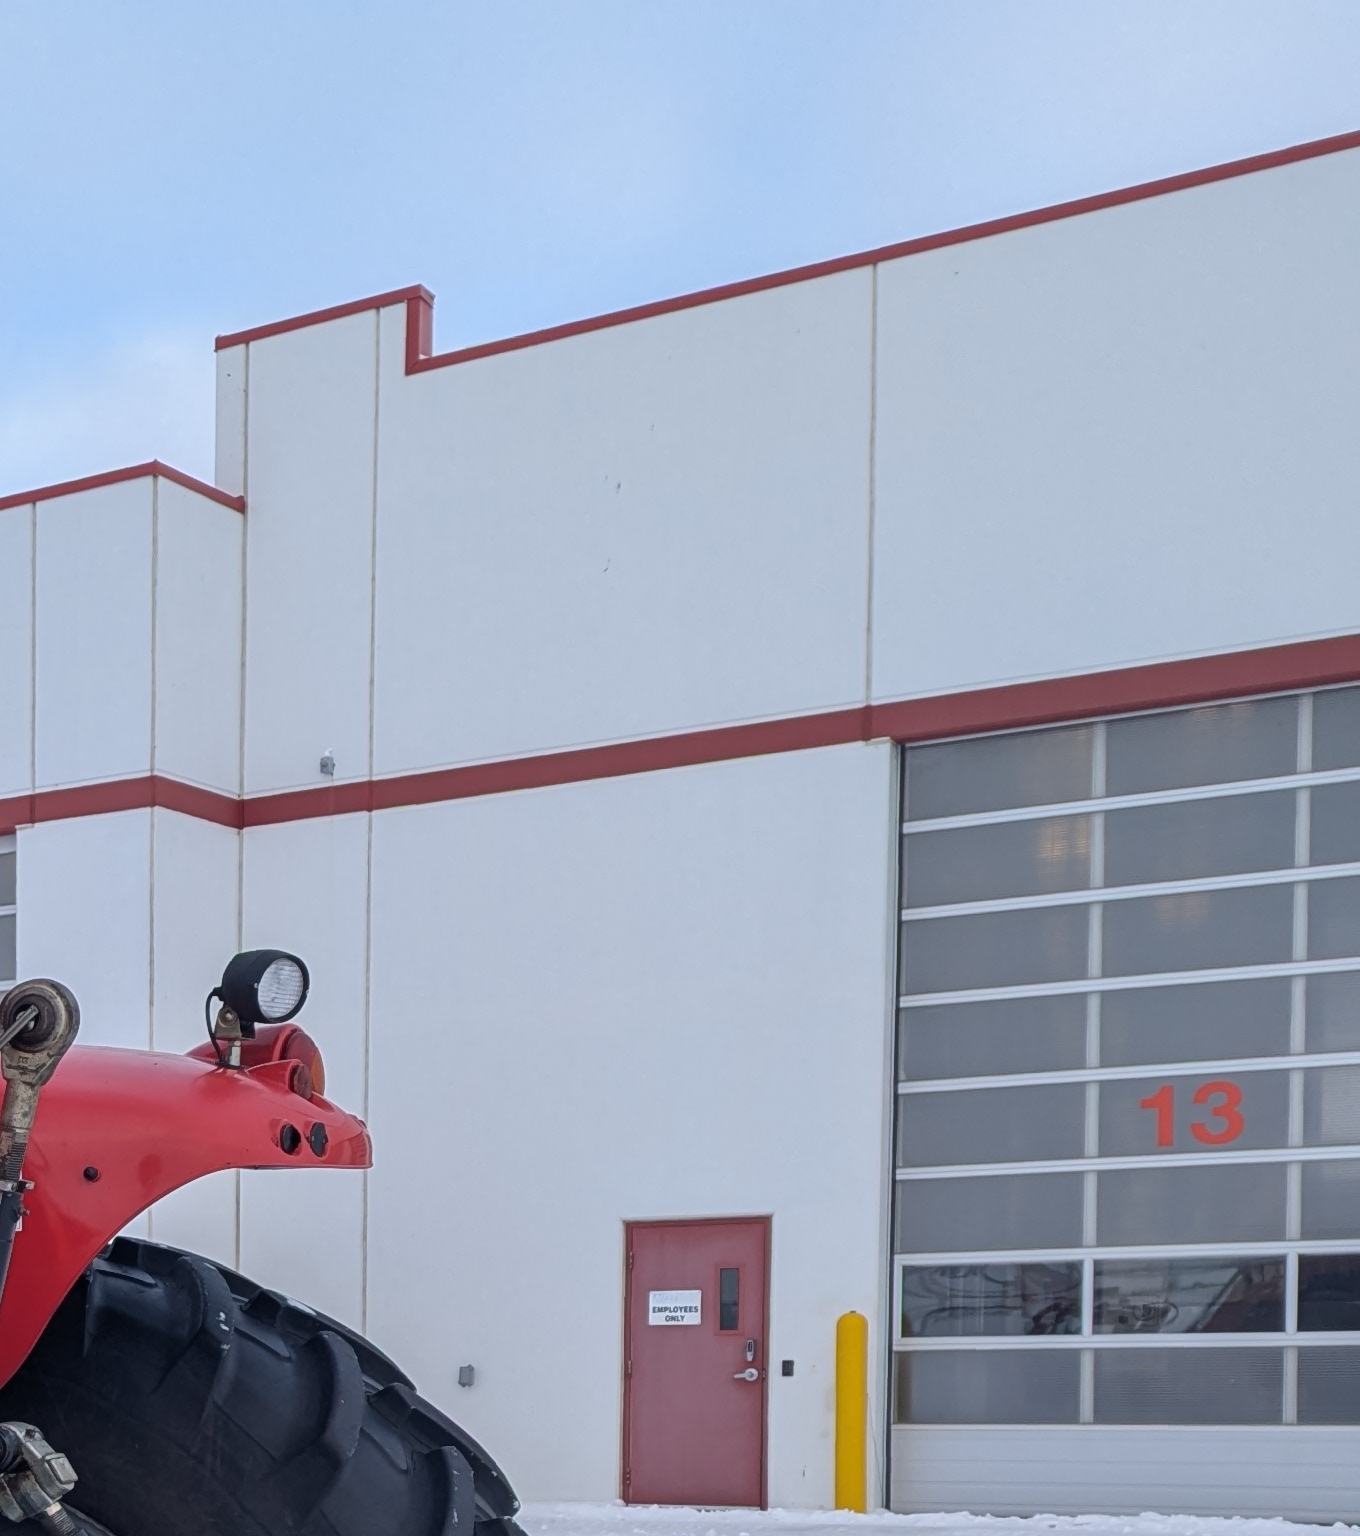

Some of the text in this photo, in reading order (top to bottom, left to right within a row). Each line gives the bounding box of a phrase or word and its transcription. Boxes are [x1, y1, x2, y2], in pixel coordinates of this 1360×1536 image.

[1139, 1080, 1245, 1147] 13
[652, 1305, 699, 1314] EMPLOYEES
[664, 1314, 686, 1323] ONLY
